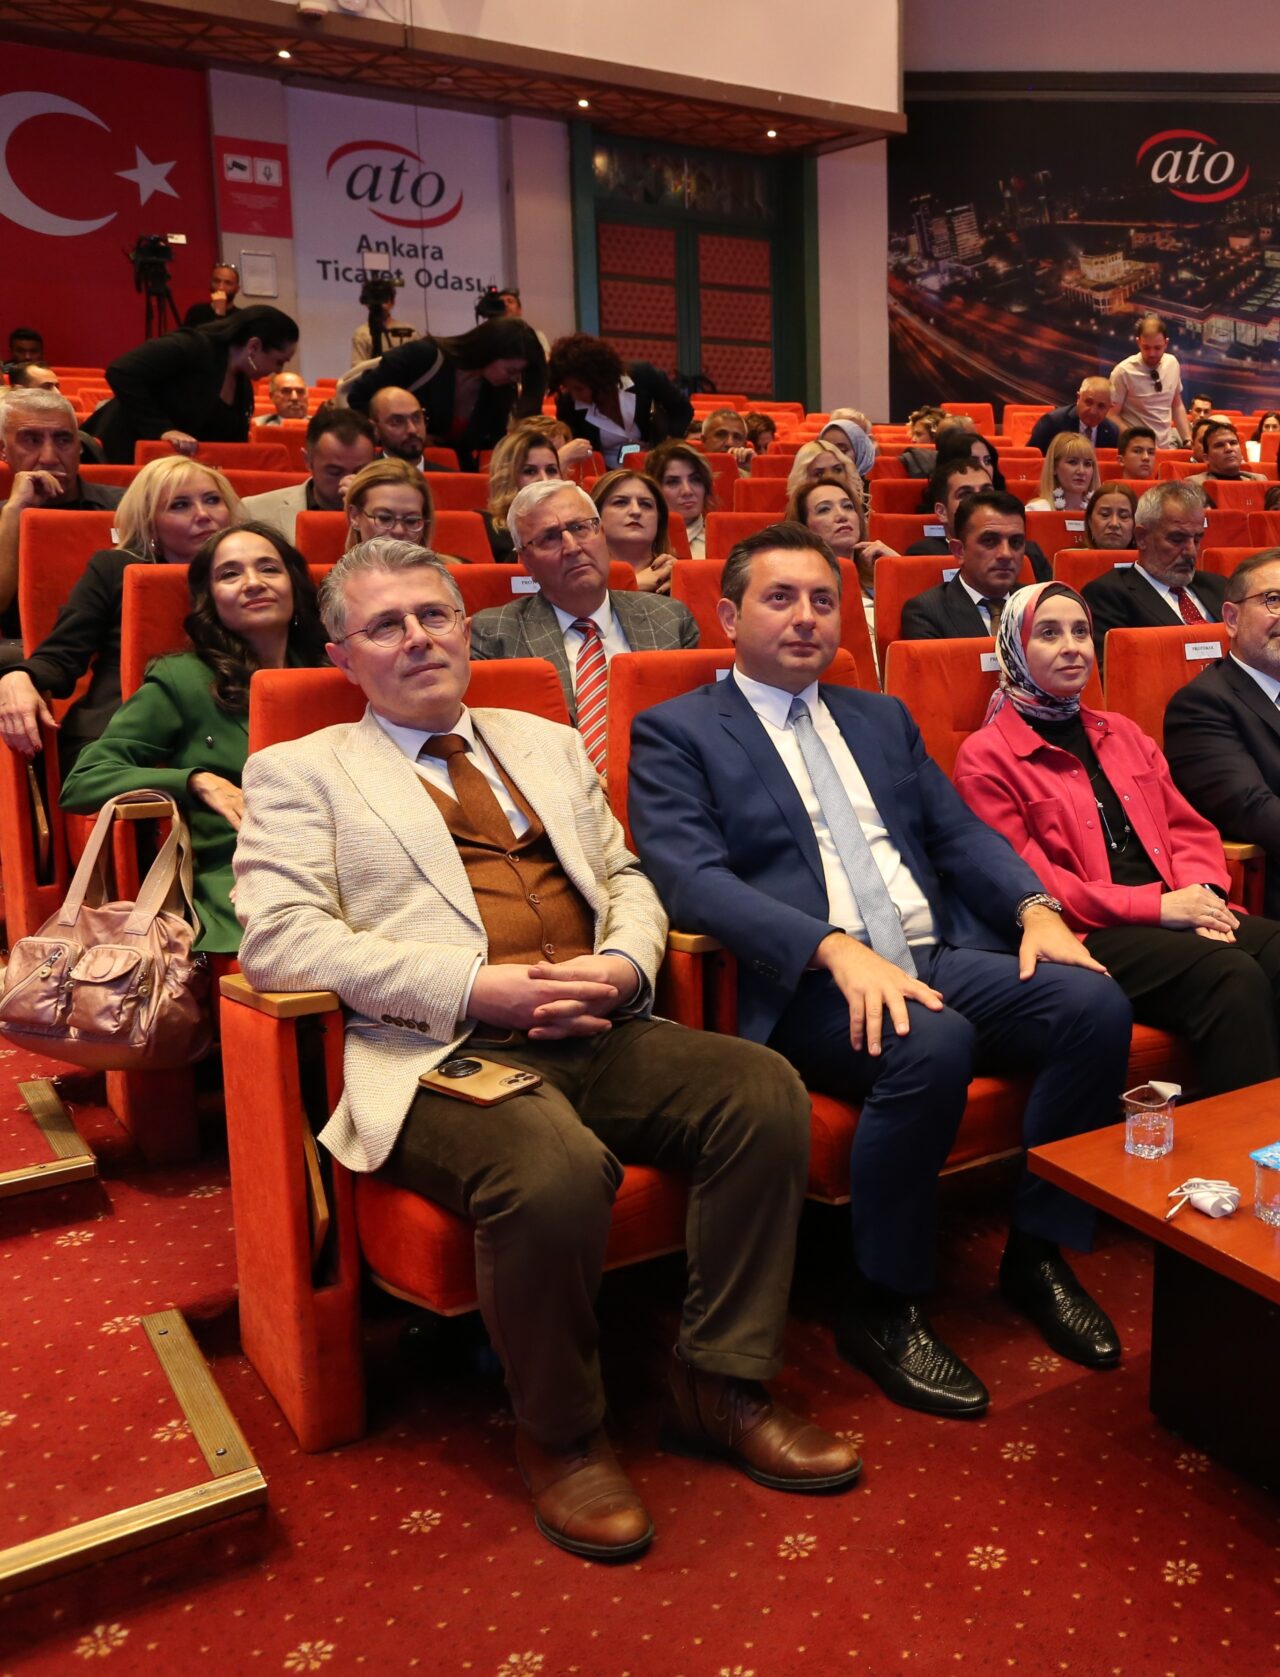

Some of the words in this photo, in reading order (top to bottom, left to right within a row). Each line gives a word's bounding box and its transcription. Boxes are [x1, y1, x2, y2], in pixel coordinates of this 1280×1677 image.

[1151, 142, 1235, 184] ato
[346, 159, 445, 208] ato
[356, 234, 443, 261] Ankara
[316, 260, 404, 284] Ticaet
[415, 268, 485, 292] Odası
